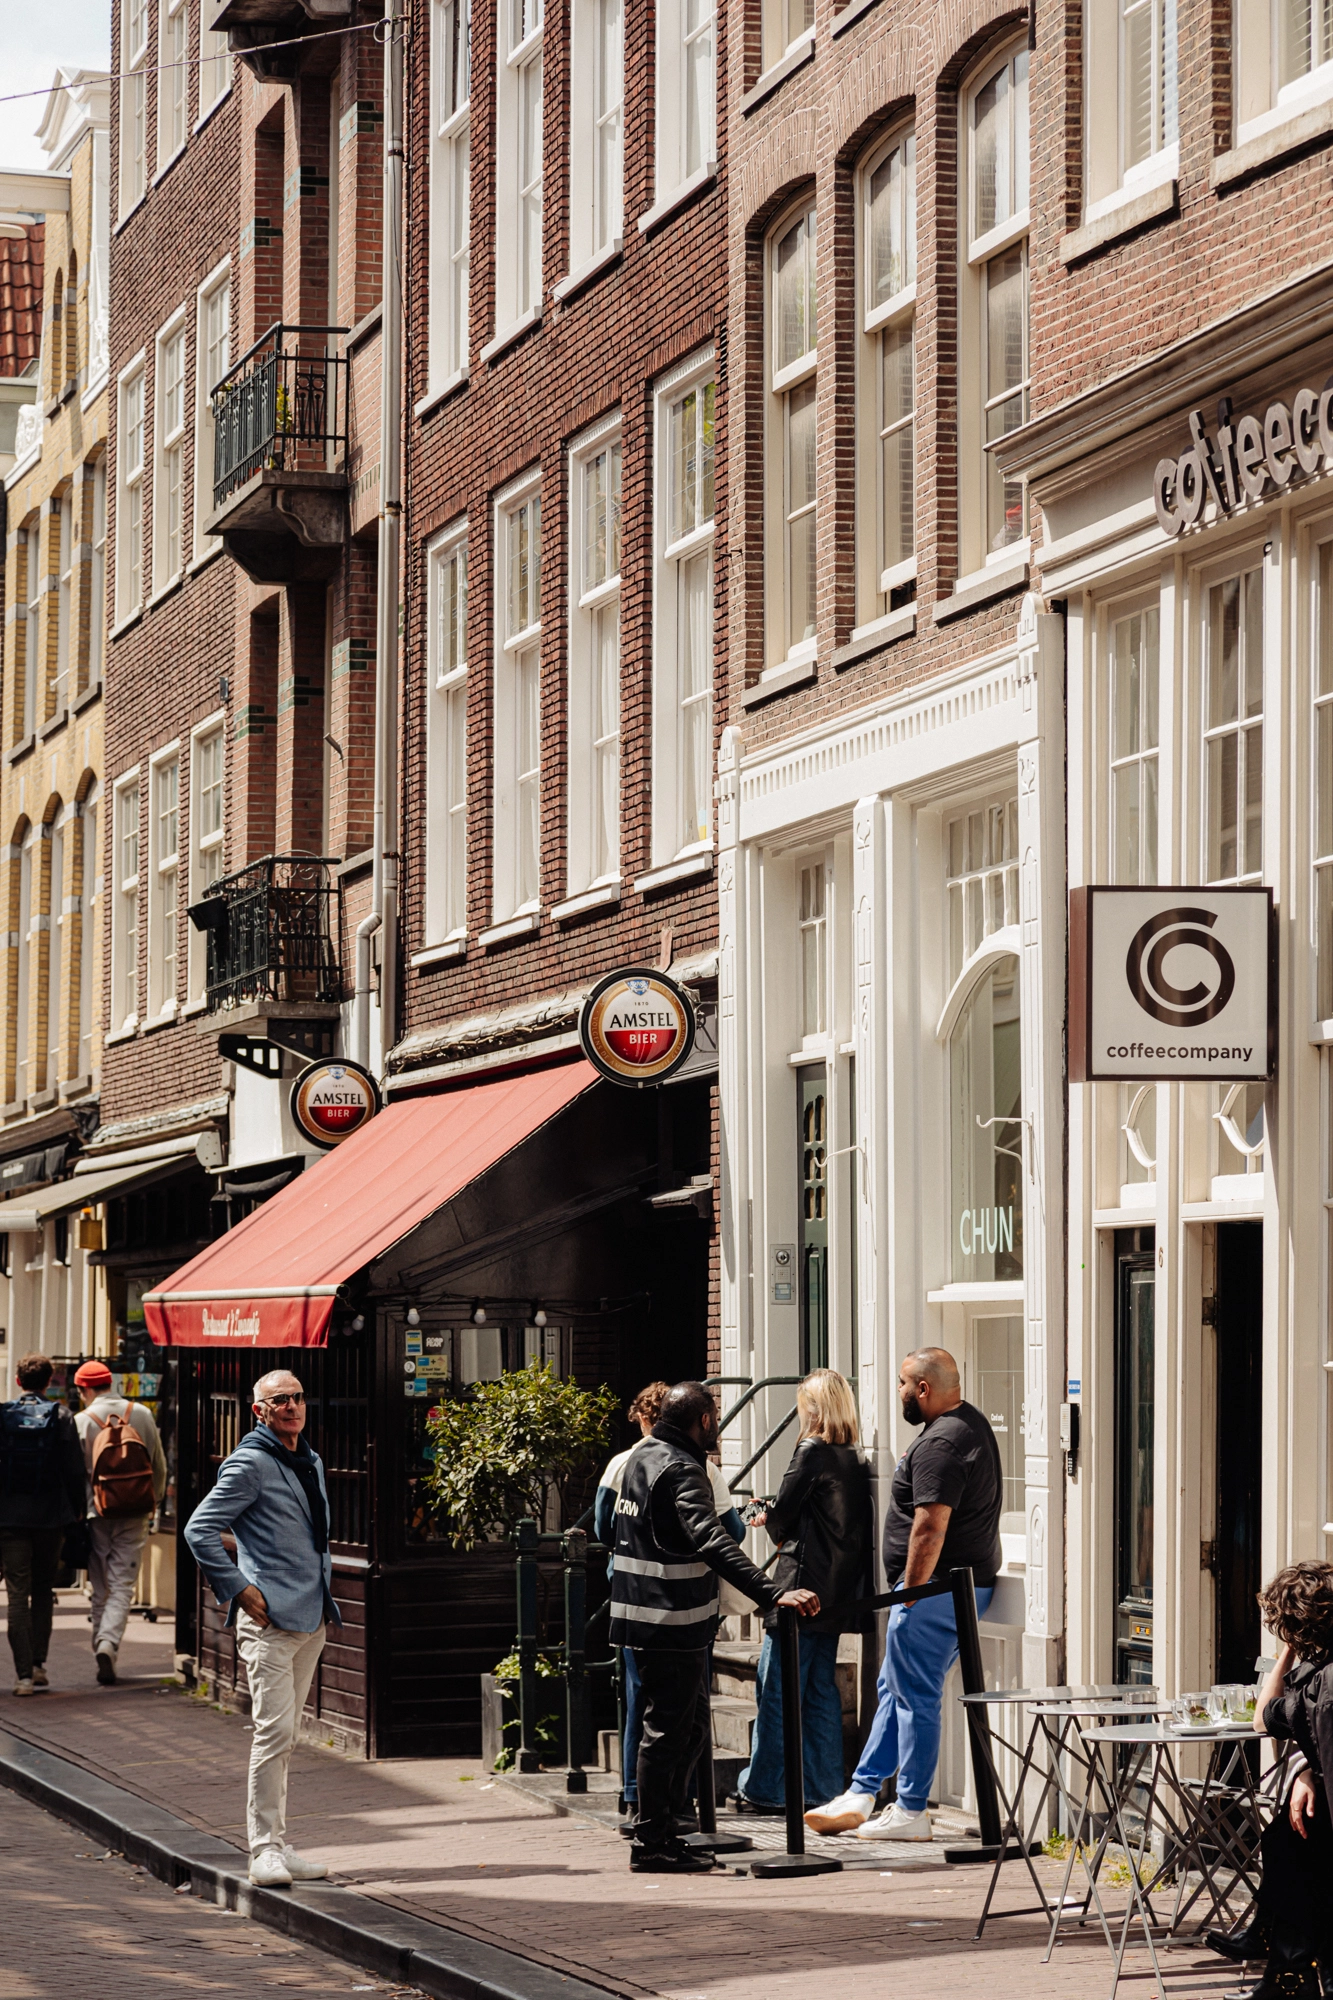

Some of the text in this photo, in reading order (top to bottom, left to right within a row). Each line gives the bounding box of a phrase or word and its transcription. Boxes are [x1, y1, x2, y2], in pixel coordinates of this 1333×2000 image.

[609, 1012, 674, 1028] AMSTEL
[629, 1033, 657, 1044] BIER
[1106, 1043, 1253, 1062] coffeecompany
[312, 1093, 364, 1105] AMSTEL
[327, 1109, 350, 1118] BIER
[959, 1205, 1013, 1256] CHUN
